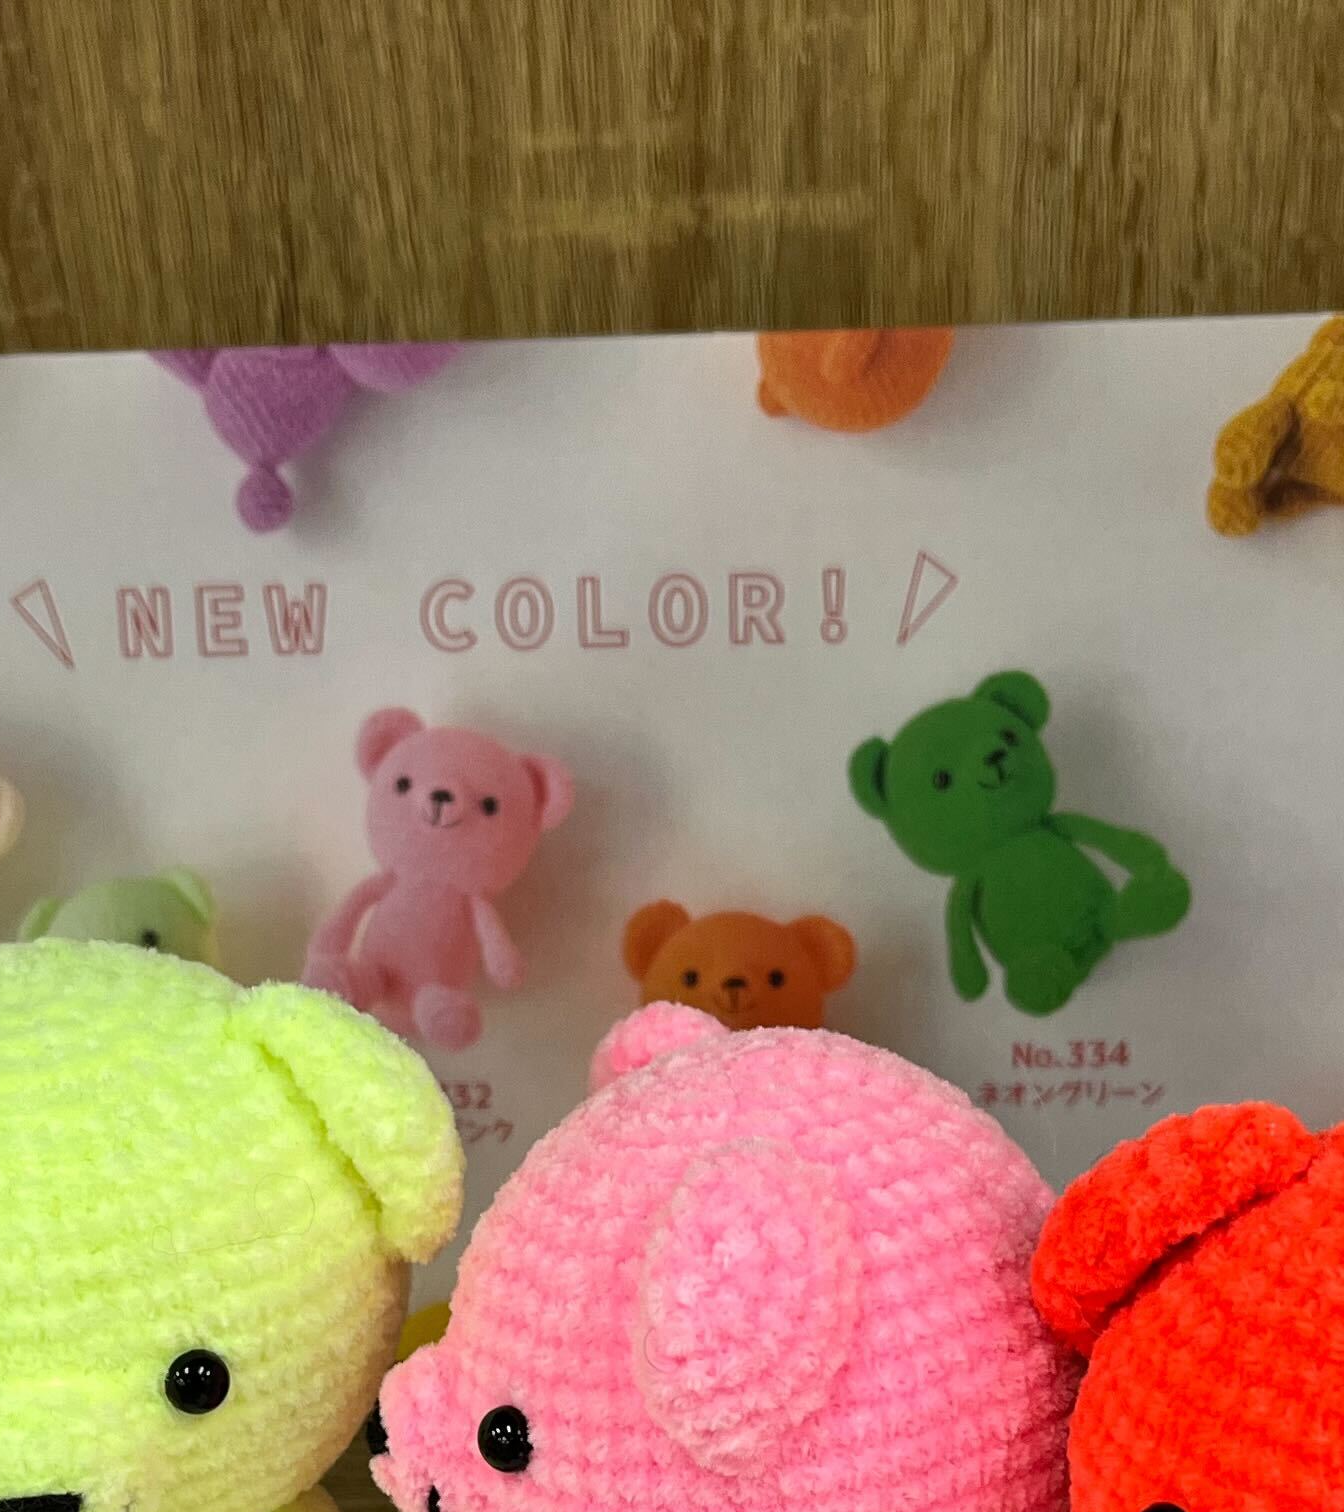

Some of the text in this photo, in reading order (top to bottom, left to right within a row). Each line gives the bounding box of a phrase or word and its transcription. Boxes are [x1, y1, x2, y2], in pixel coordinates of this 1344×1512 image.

[116, 567, 849, 658] NEW COLOR!
[1011, 1040, 1131, 1069] No.334
[978, 1081, 1166, 1108] ネオングリーン
